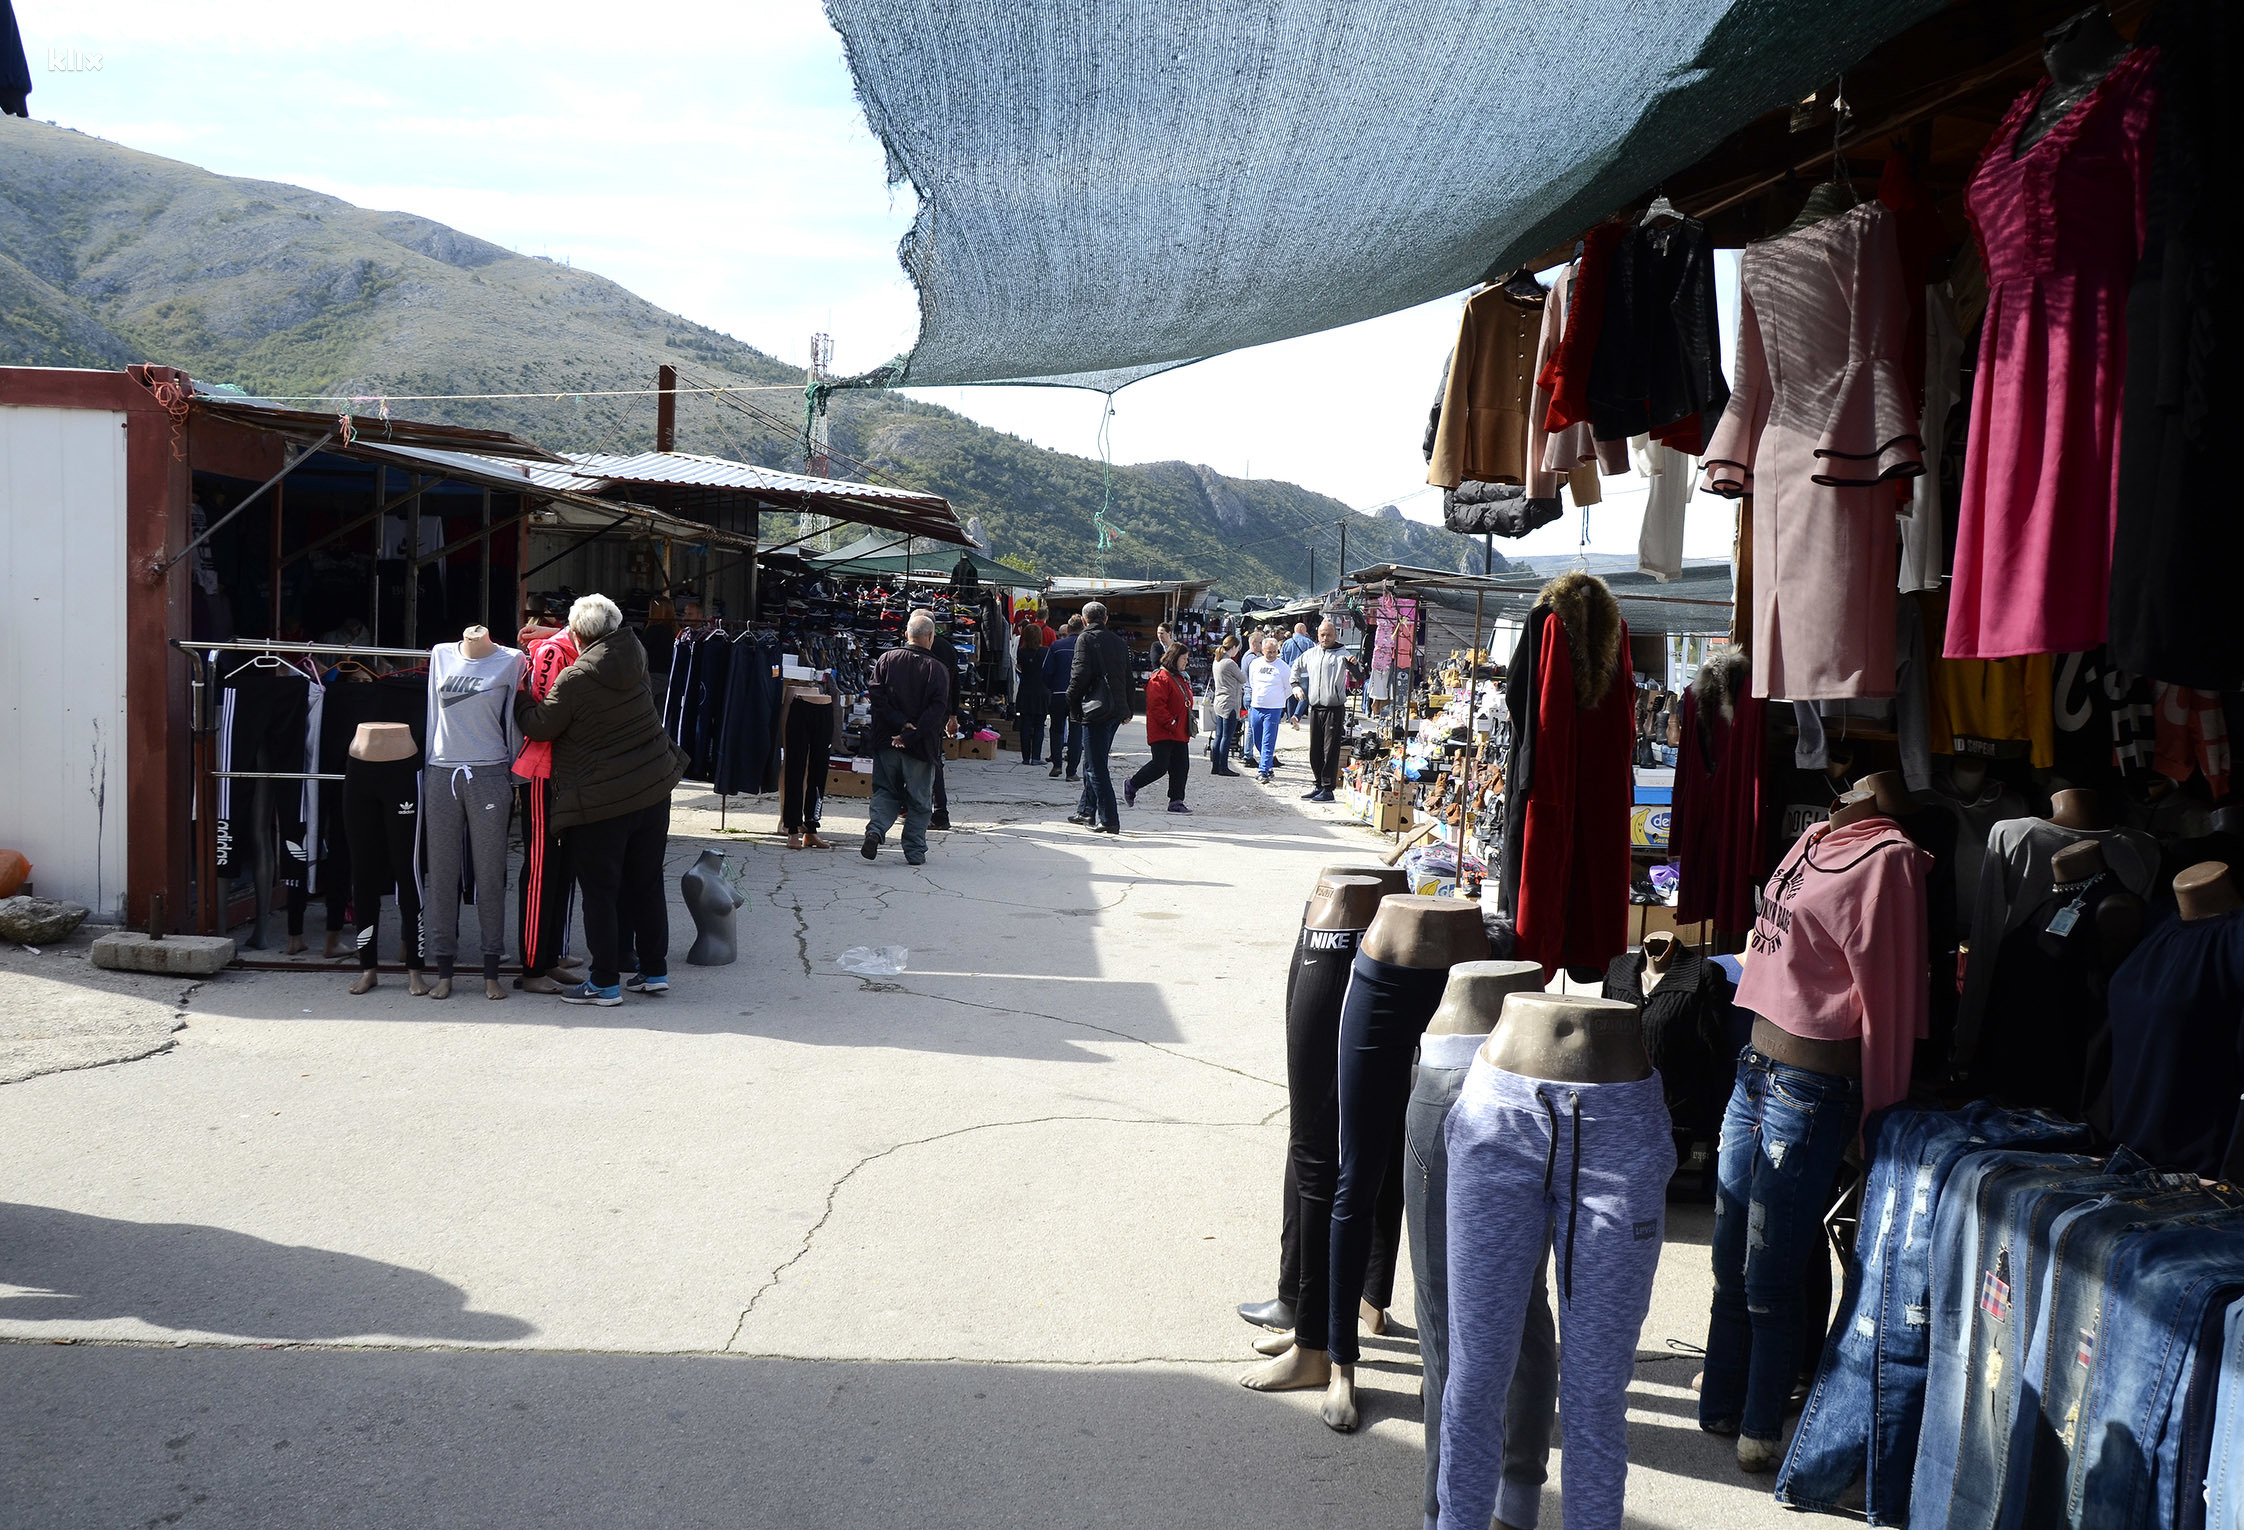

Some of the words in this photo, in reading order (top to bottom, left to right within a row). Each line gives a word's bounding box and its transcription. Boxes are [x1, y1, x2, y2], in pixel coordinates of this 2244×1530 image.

[440, 675, 486, 693] NIKE
[216, 820, 233, 866] adidas
[1310, 931, 1351, 949] NIKE
